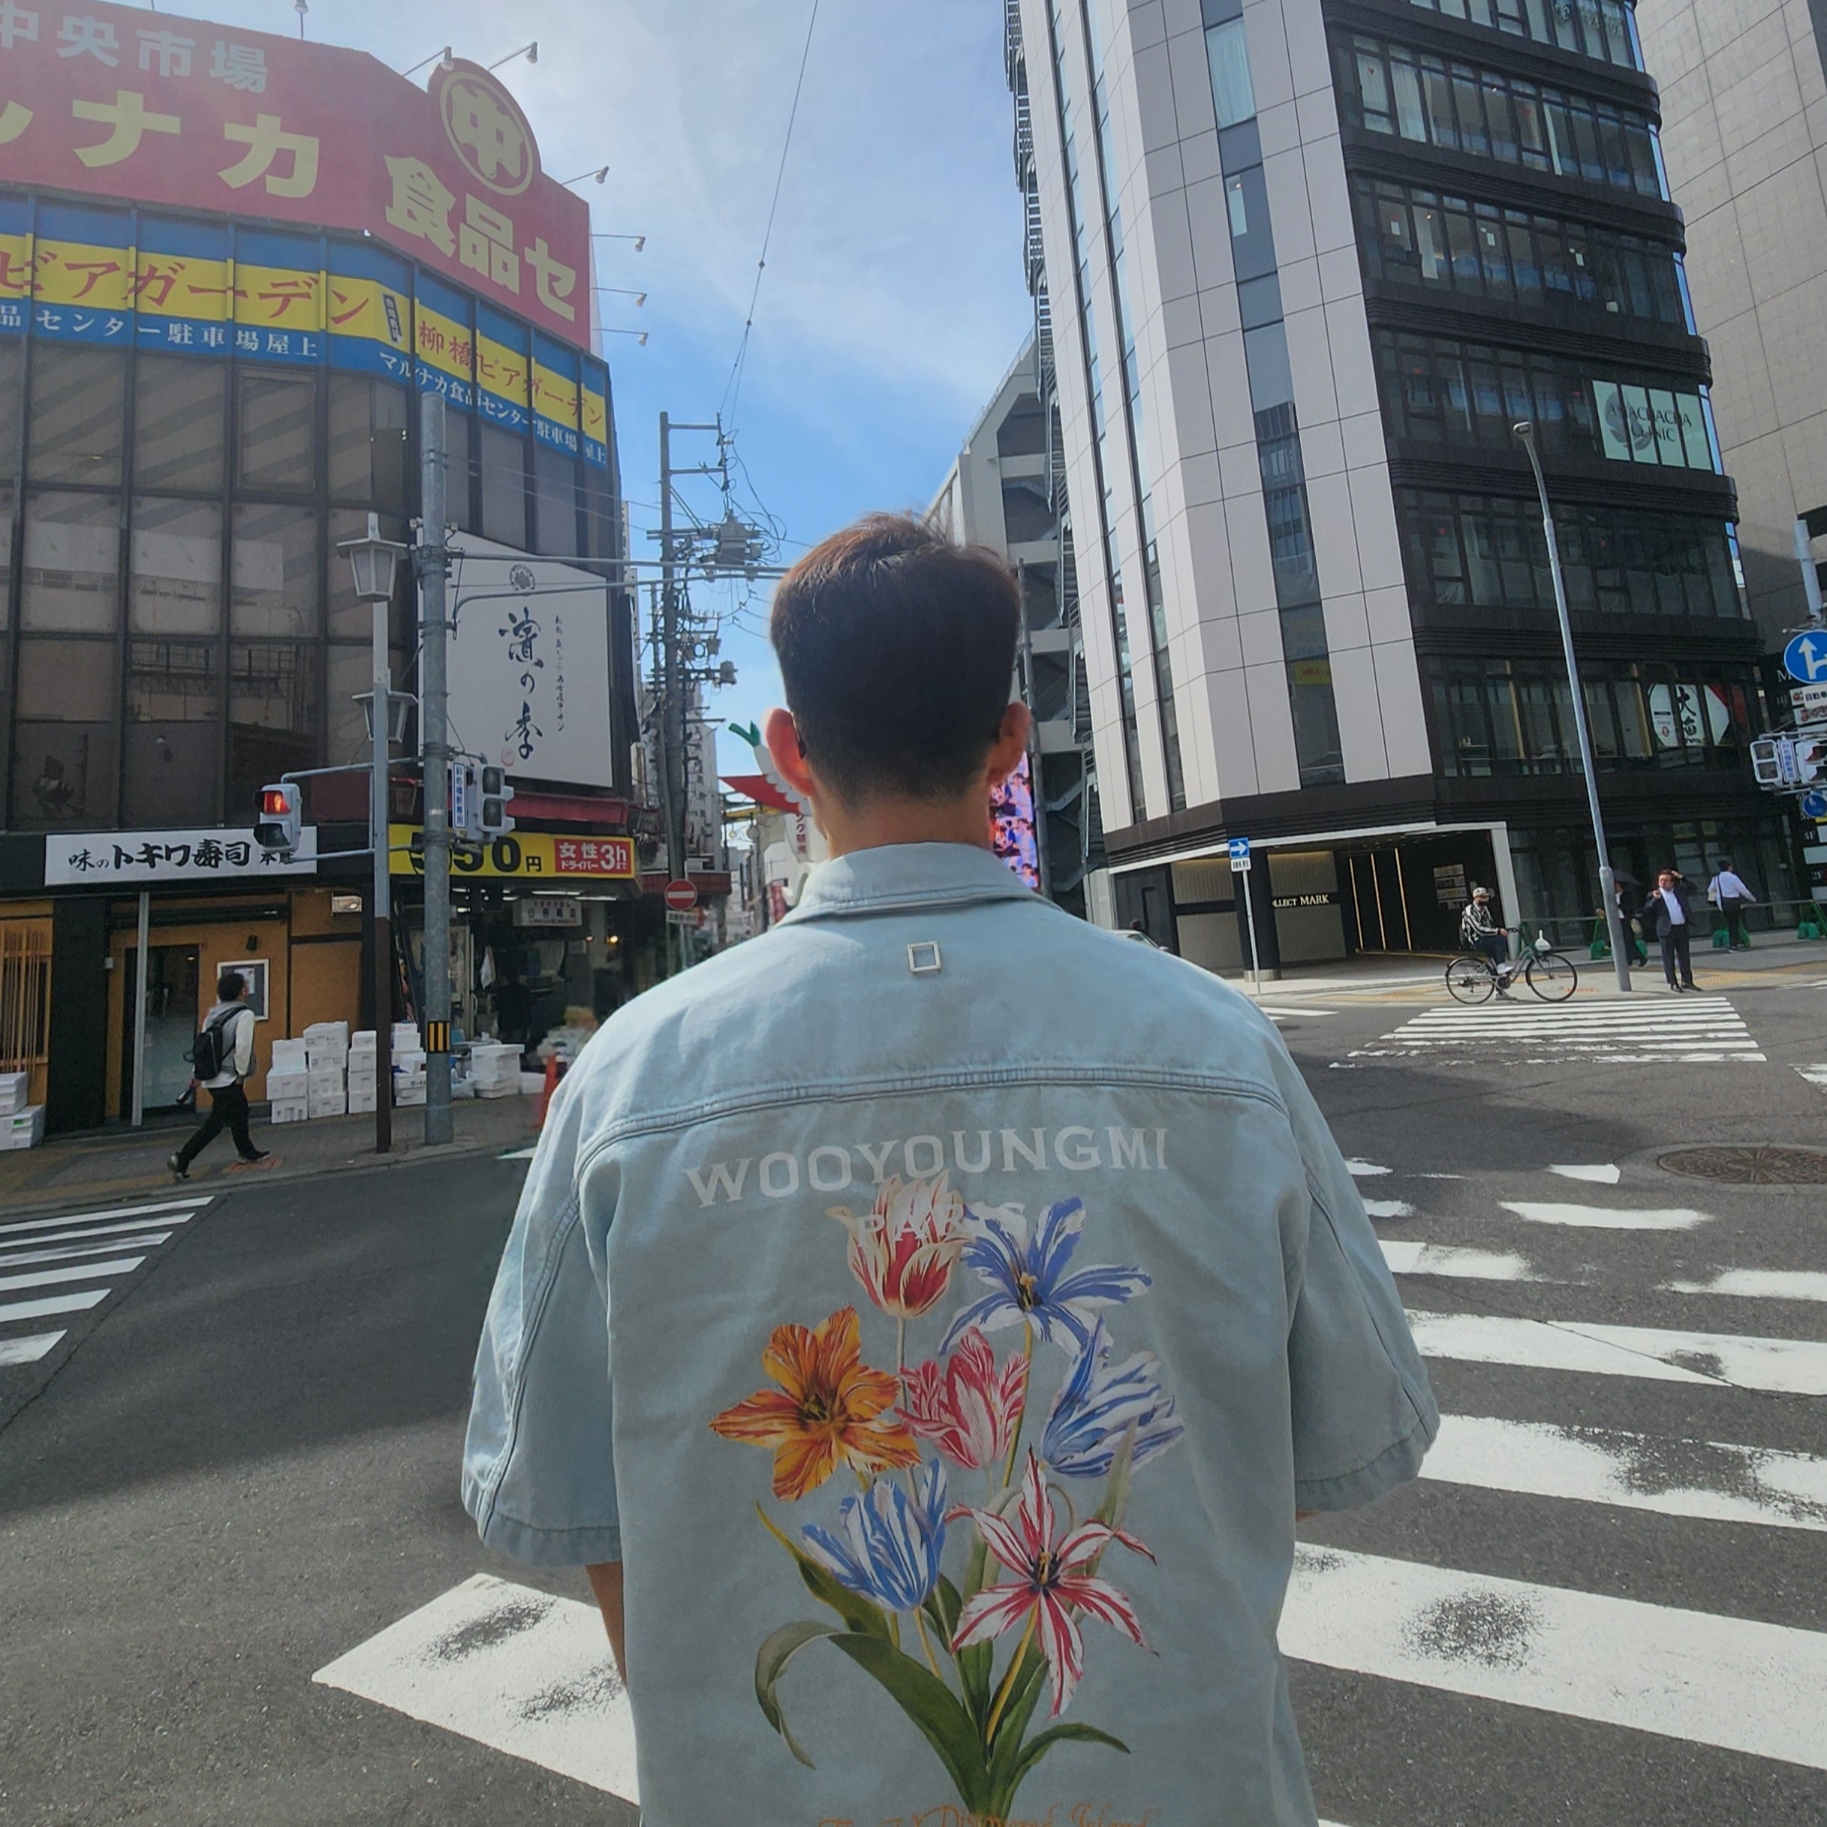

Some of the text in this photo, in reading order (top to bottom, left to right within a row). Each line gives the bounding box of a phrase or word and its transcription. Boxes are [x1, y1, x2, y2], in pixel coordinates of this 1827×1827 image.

[0, 1, 268, 93] 中央市場
[383, 154, 576, 322] 食品セ
[0, 250, 369, 325] ビアガーデン
[418, 319, 602, 425] 柳橋ビアガーデン
[559, 841, 598, 859] 女性
[561, 860, 599, 870] ドライバー
[1300, 894, 1330, 906] MARK
[683, 1125, 1169, 1209] WOOYOUNGMI
